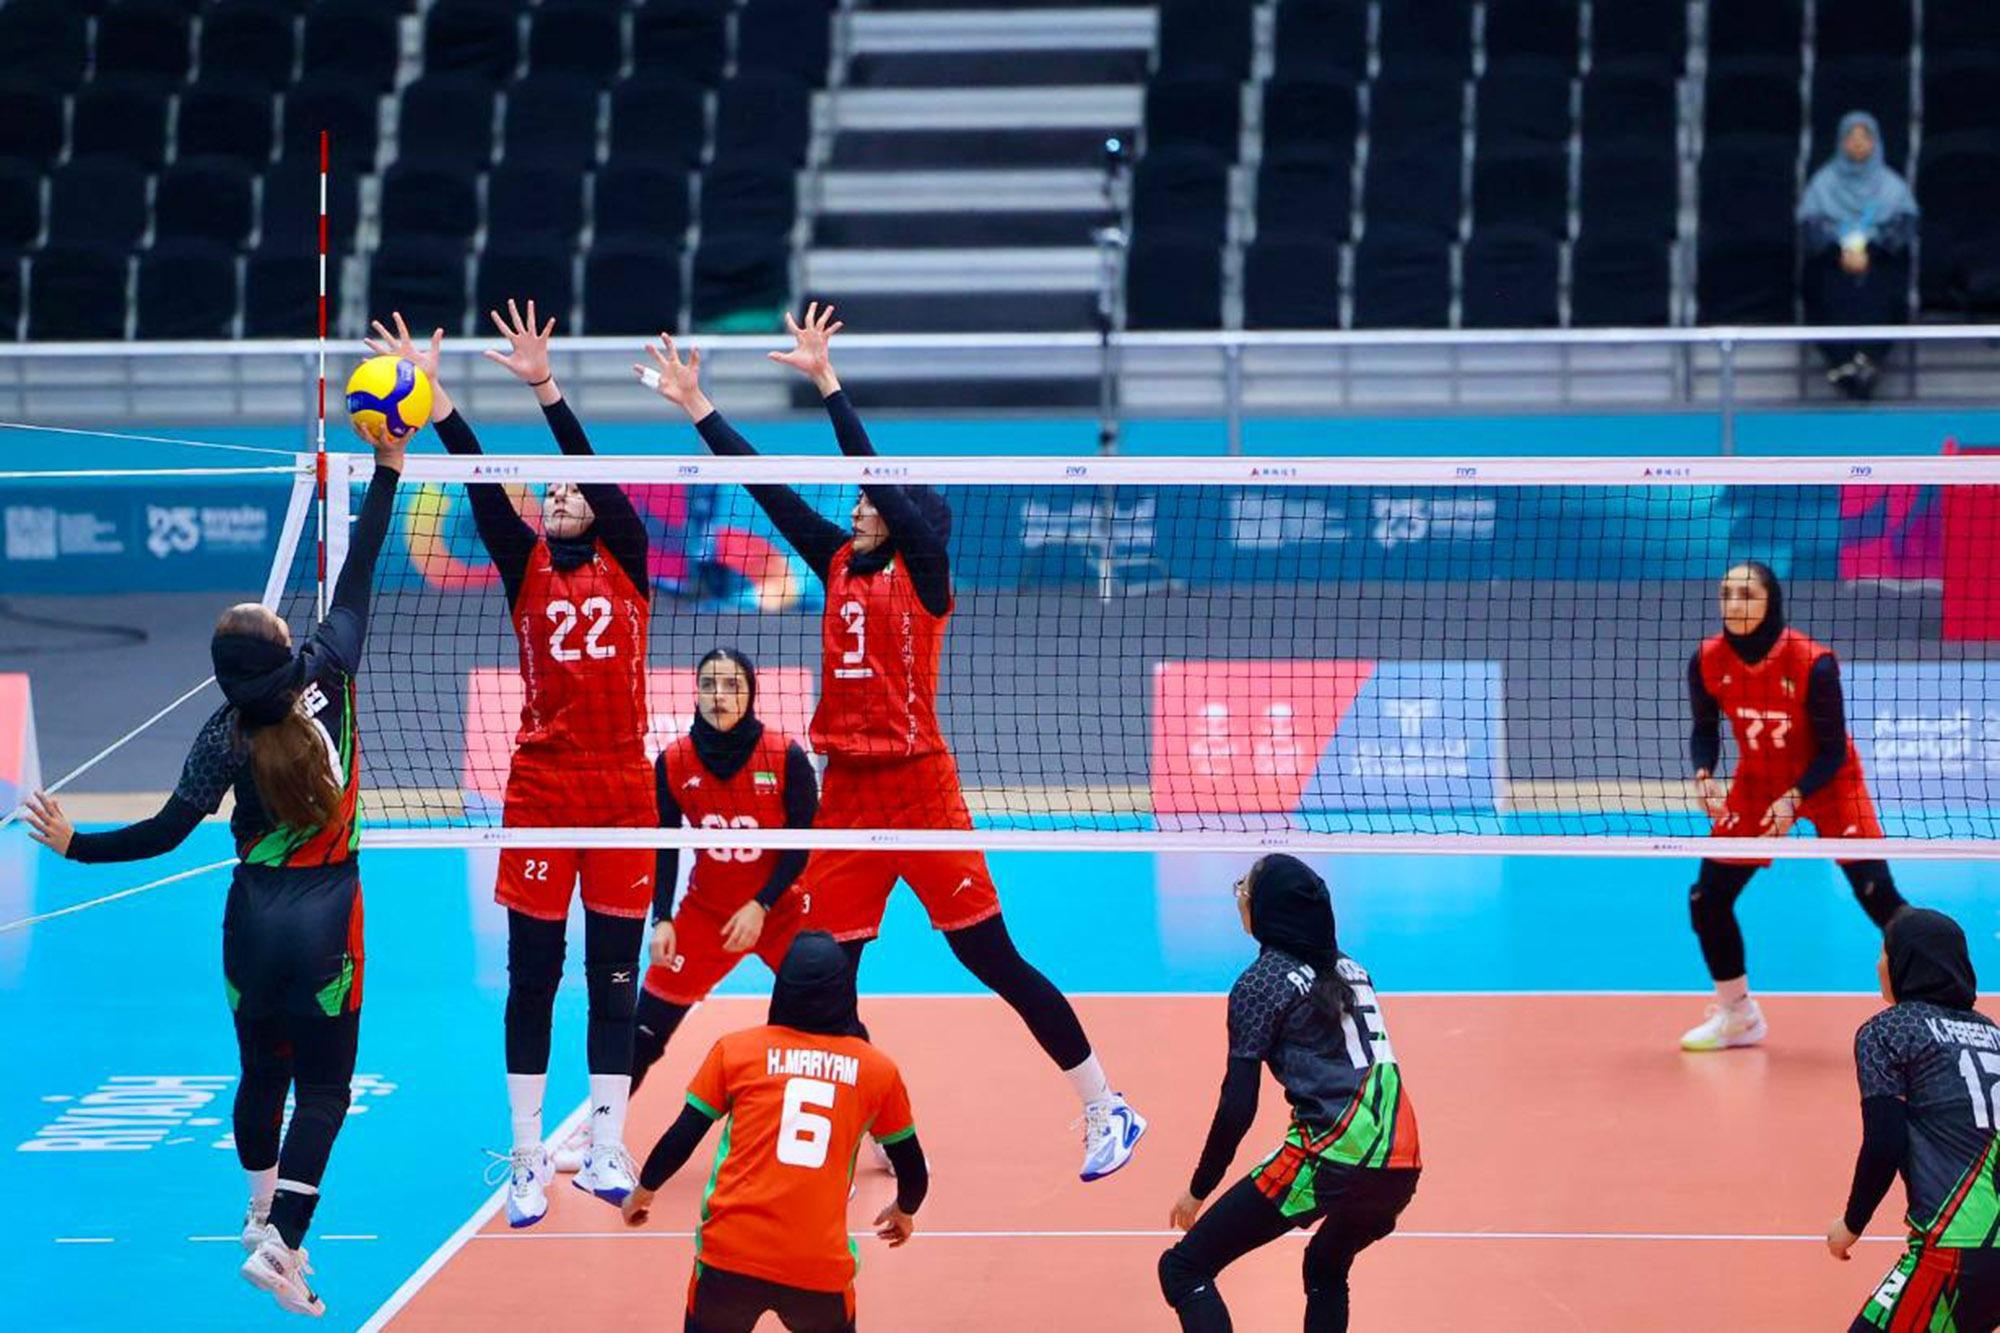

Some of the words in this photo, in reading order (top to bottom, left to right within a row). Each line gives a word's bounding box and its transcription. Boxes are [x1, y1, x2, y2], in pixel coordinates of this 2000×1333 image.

[546, 596, 617, 662] 22
[840, 601, 866, 664] 3
[1736, 707, 1792, 749] 77
[524, 859, 549, 880] 22
[16, 1075, 238, 1151] RIYADH
[777, 1077, 836, 1169] 6
